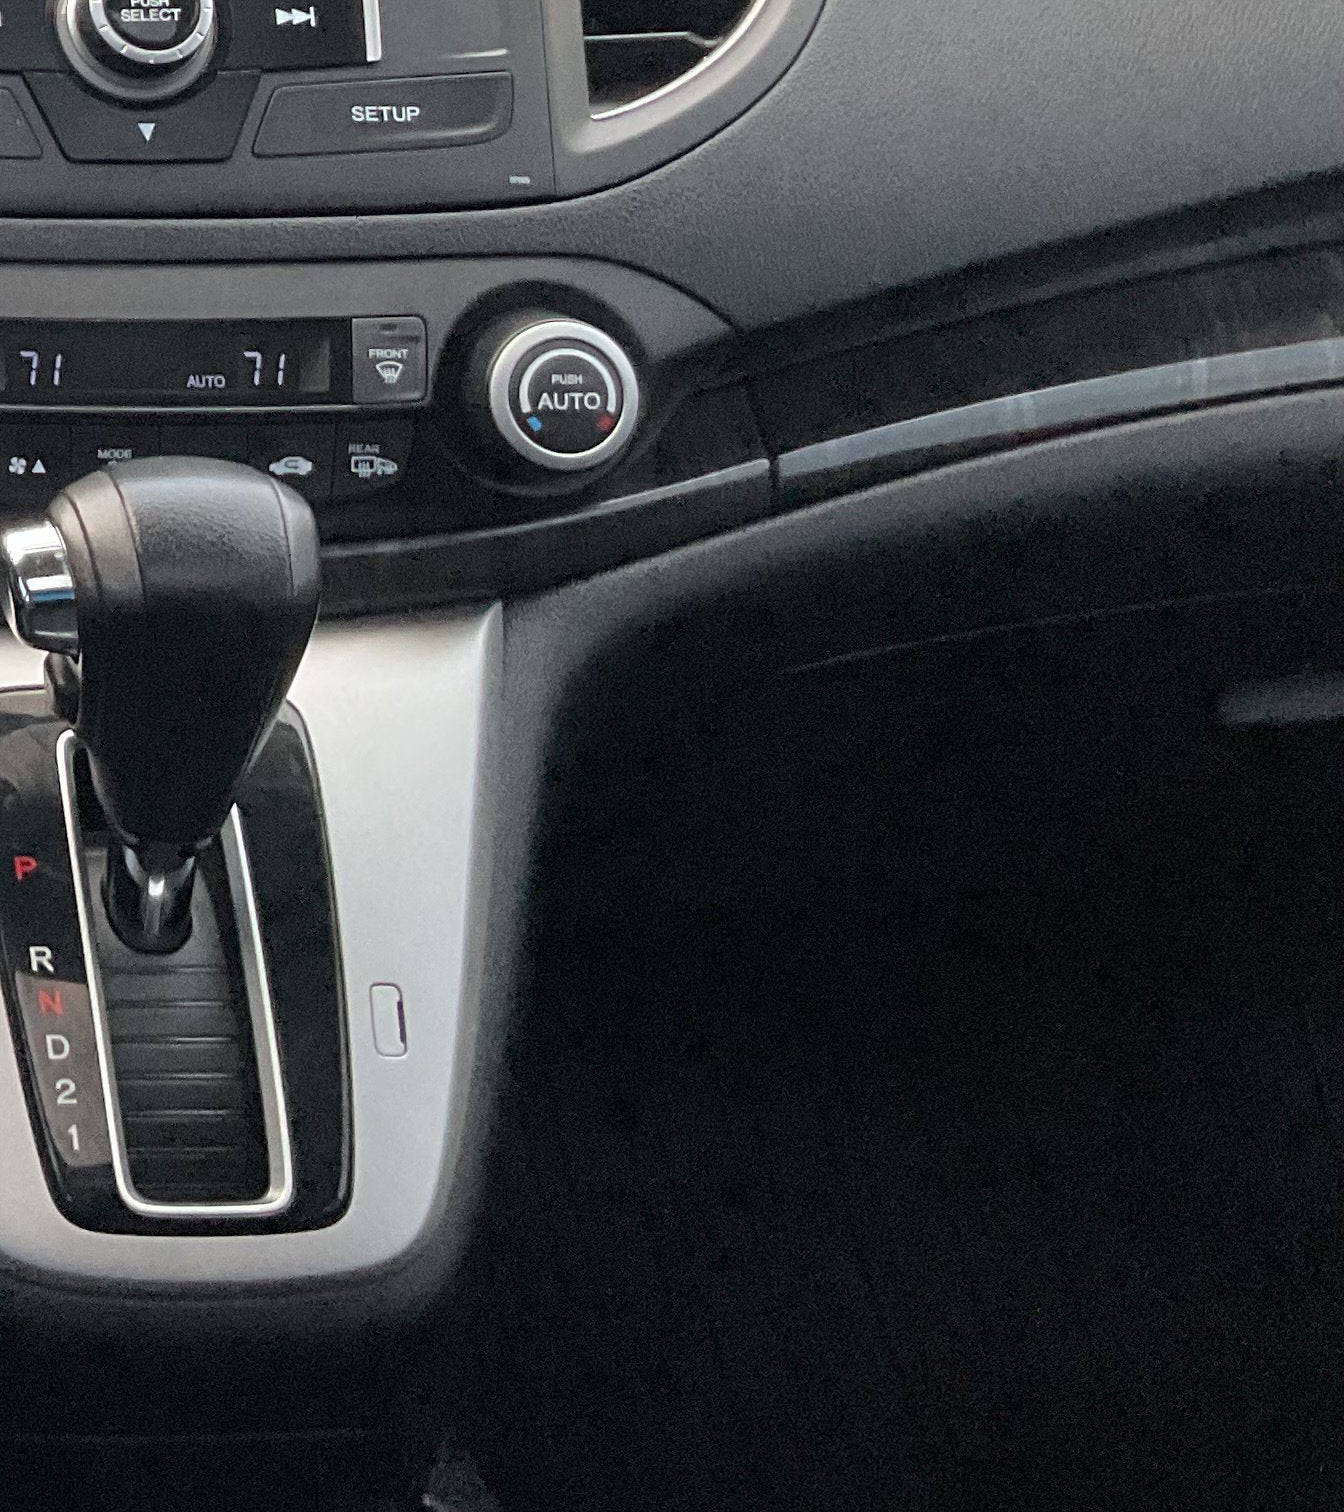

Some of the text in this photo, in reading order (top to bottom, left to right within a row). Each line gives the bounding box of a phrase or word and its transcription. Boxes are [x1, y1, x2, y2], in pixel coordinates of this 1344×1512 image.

[120, 7, 182, 22] SELECT
[350, 105, 421, 122] SETUP
[368, 347, 409, 360] FRONT
[20, 350, 62, 386] 71
[243, 351, 286, 387] 71
[186, 374, 226, 389] AUTO
[551, 373, 583, 385] PUSH
[537, 392, 601, 410] AUTO
[97, 448, 133, 460] MODE
[348, 443, 380, 455] REAR
[13, 855, 39, 880] P
[28, 945, 55, 972] R
[36, 989, 63, 1017] N
[45, 1033, 71, 1061] D
[55, 1078, 78, 1104] 2
[67, 1123, 80, 1151] 1
